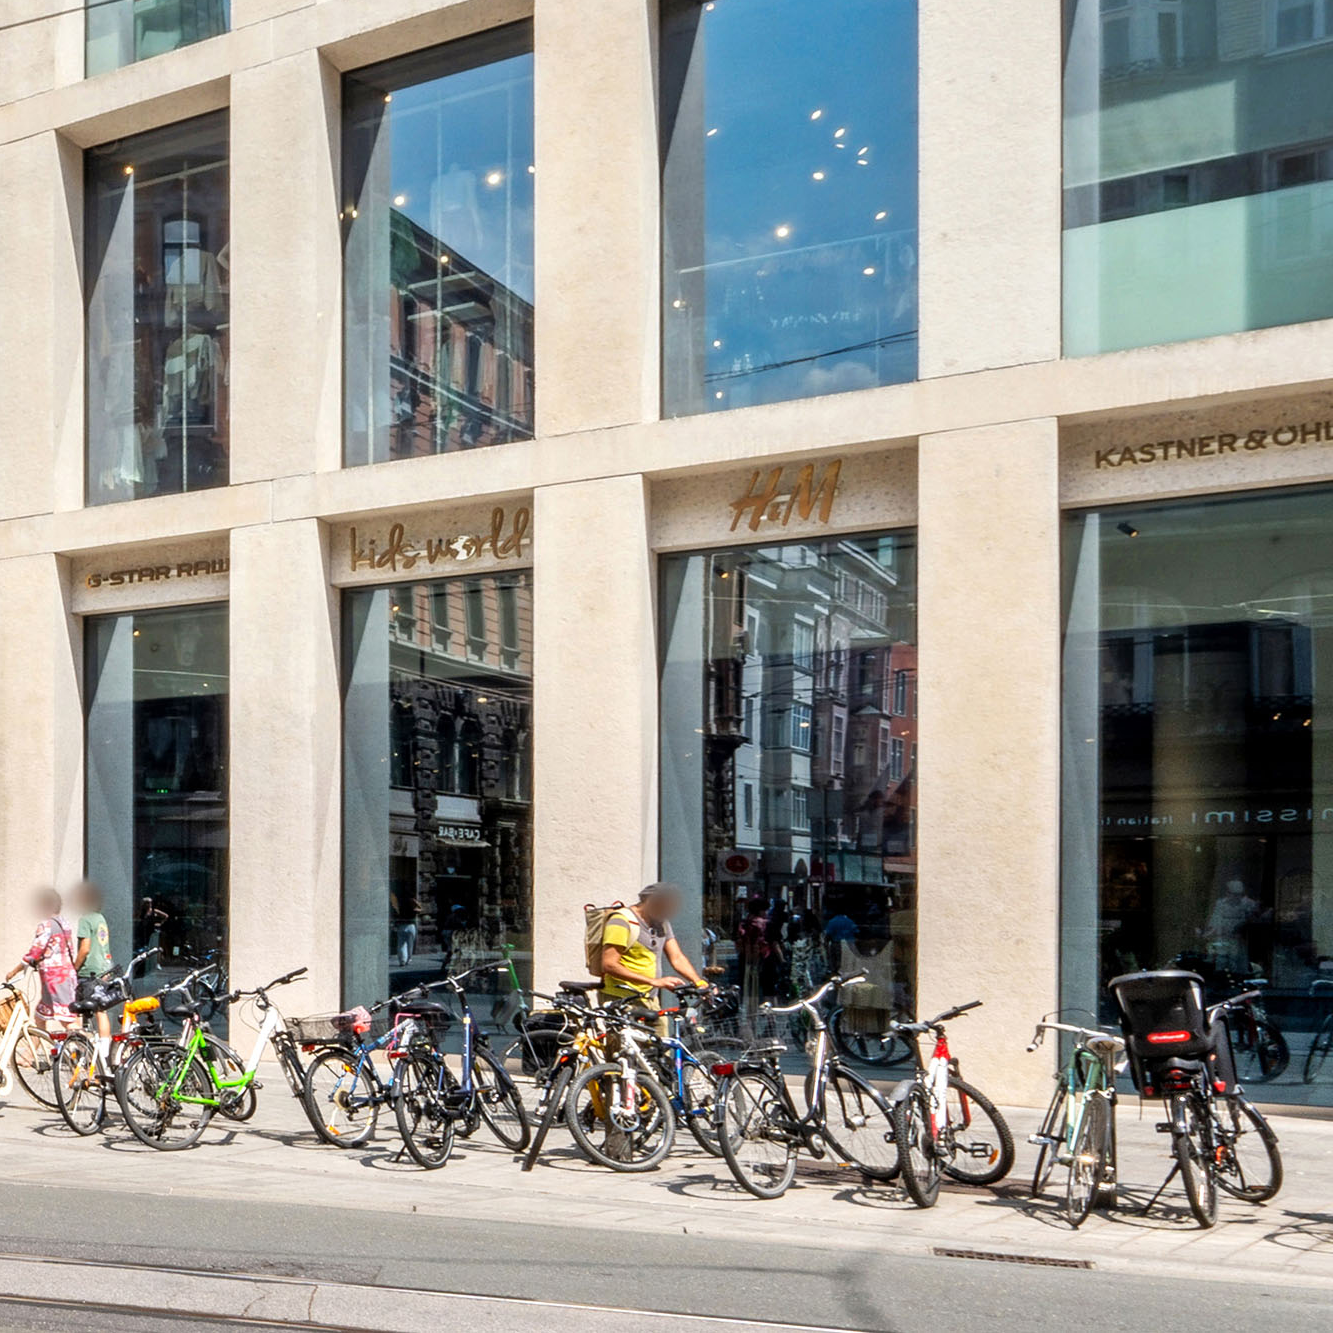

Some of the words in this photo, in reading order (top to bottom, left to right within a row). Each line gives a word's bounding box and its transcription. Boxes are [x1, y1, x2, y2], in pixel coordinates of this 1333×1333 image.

[1094, 433, 1238, 469] KASTNER
[1243, 429, 1267, 451] &
[728, 458, 843, 532] H&M
[349, 521, 422, 573] kids
[426, 506, 530, 565] world
[86, 562, 171, 589] G-STAR
[176, 557, 230, 579] RAW
